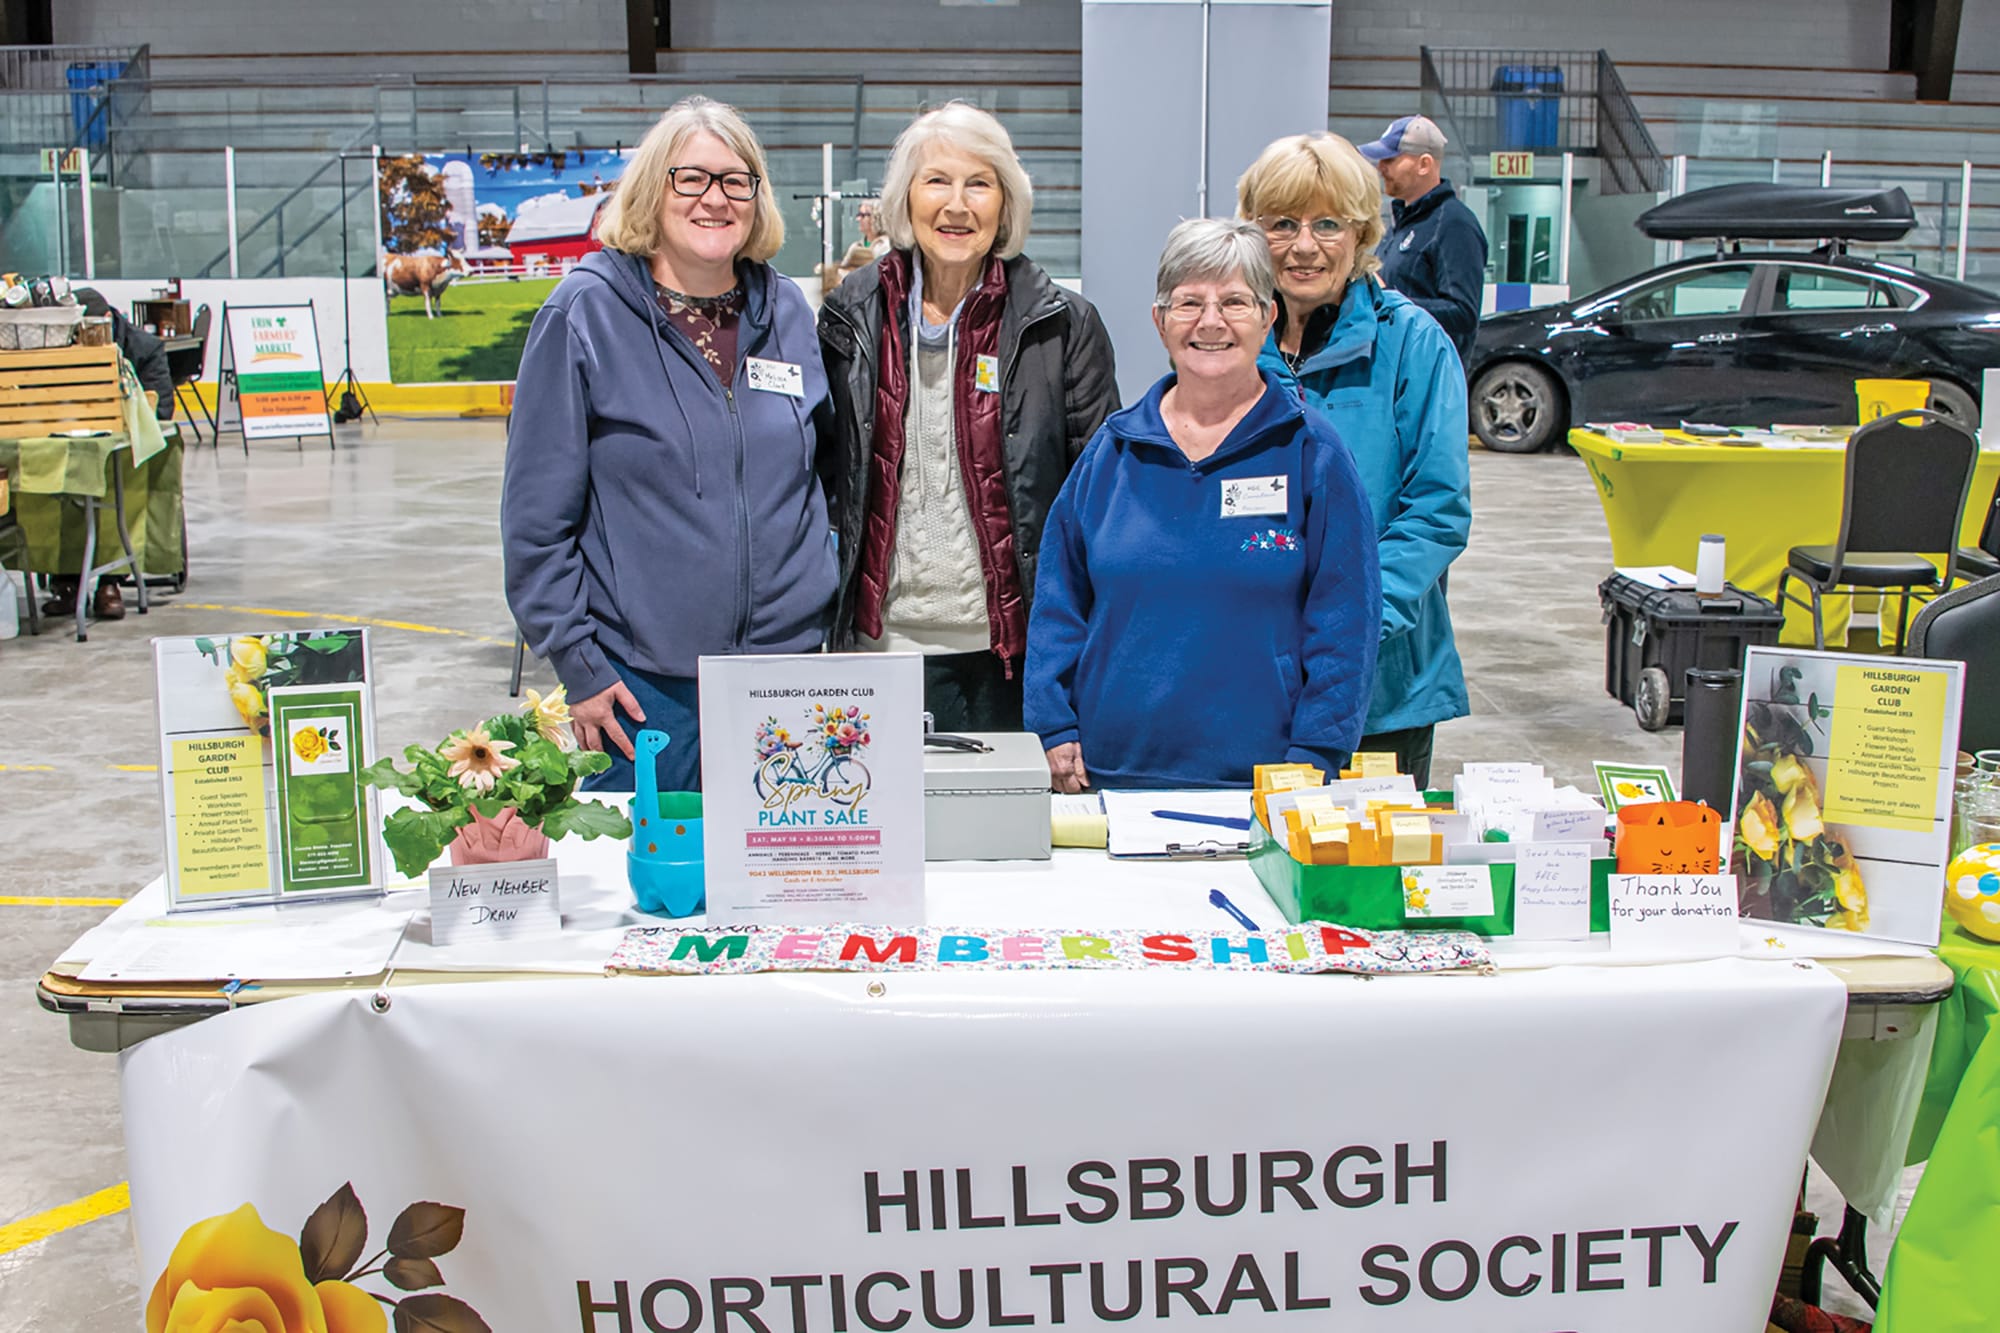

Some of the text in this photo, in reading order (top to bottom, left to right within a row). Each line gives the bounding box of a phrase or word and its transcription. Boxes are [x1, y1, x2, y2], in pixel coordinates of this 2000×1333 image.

[1497, 154, 1528, 176] EXIT
[251, 317, 272, 328] ERIN
[255, 343, 292, 353] MARKET
[1863, 671, 1920, 683] HILLSBURGH
[749, 688, 874, 698] HILLSBURGH GARDEN CLUB
[1871, 684, 1910, 695] GARDEN
[1877, 698, 1901, 707] CLUB
[1887, 727, 1916, 735] Speakers
[1873, 735, 1908, 744] Workshops
[189, 740, 245, 751] HILLSBURGH
[198, 753, 237, 763] GARDEN
[206, 766, 230, 775] CLUB
[1881, 772, 1926, 782] Beautification
[762, 751, 869, 816] Spring
[1873, 781, 1899, 789] Projects
[220, 792, 248, 801] Speakers
[1856, 797, 1885, 807] members
[1899, 801, 1921, 810] always
[758, 809, 868, 826] PLANT SALE
[199, 820, 221, 828] Annual
[192, 844, 262, 854] Beautification Projects
[200, 864, 229, 872] members
[243, 862, 264, 870] always
[1621, 876, 1721, 896] Thank You
[1612, 899, 1732, 922] for your donation
[667, 927, 1371, 963] MEMBERSHIP
[864, 1140, 1447, 1233] HILLSBURGH
[576, 1221, 1739, 1333] HORTICULTURAL SOCIETY
